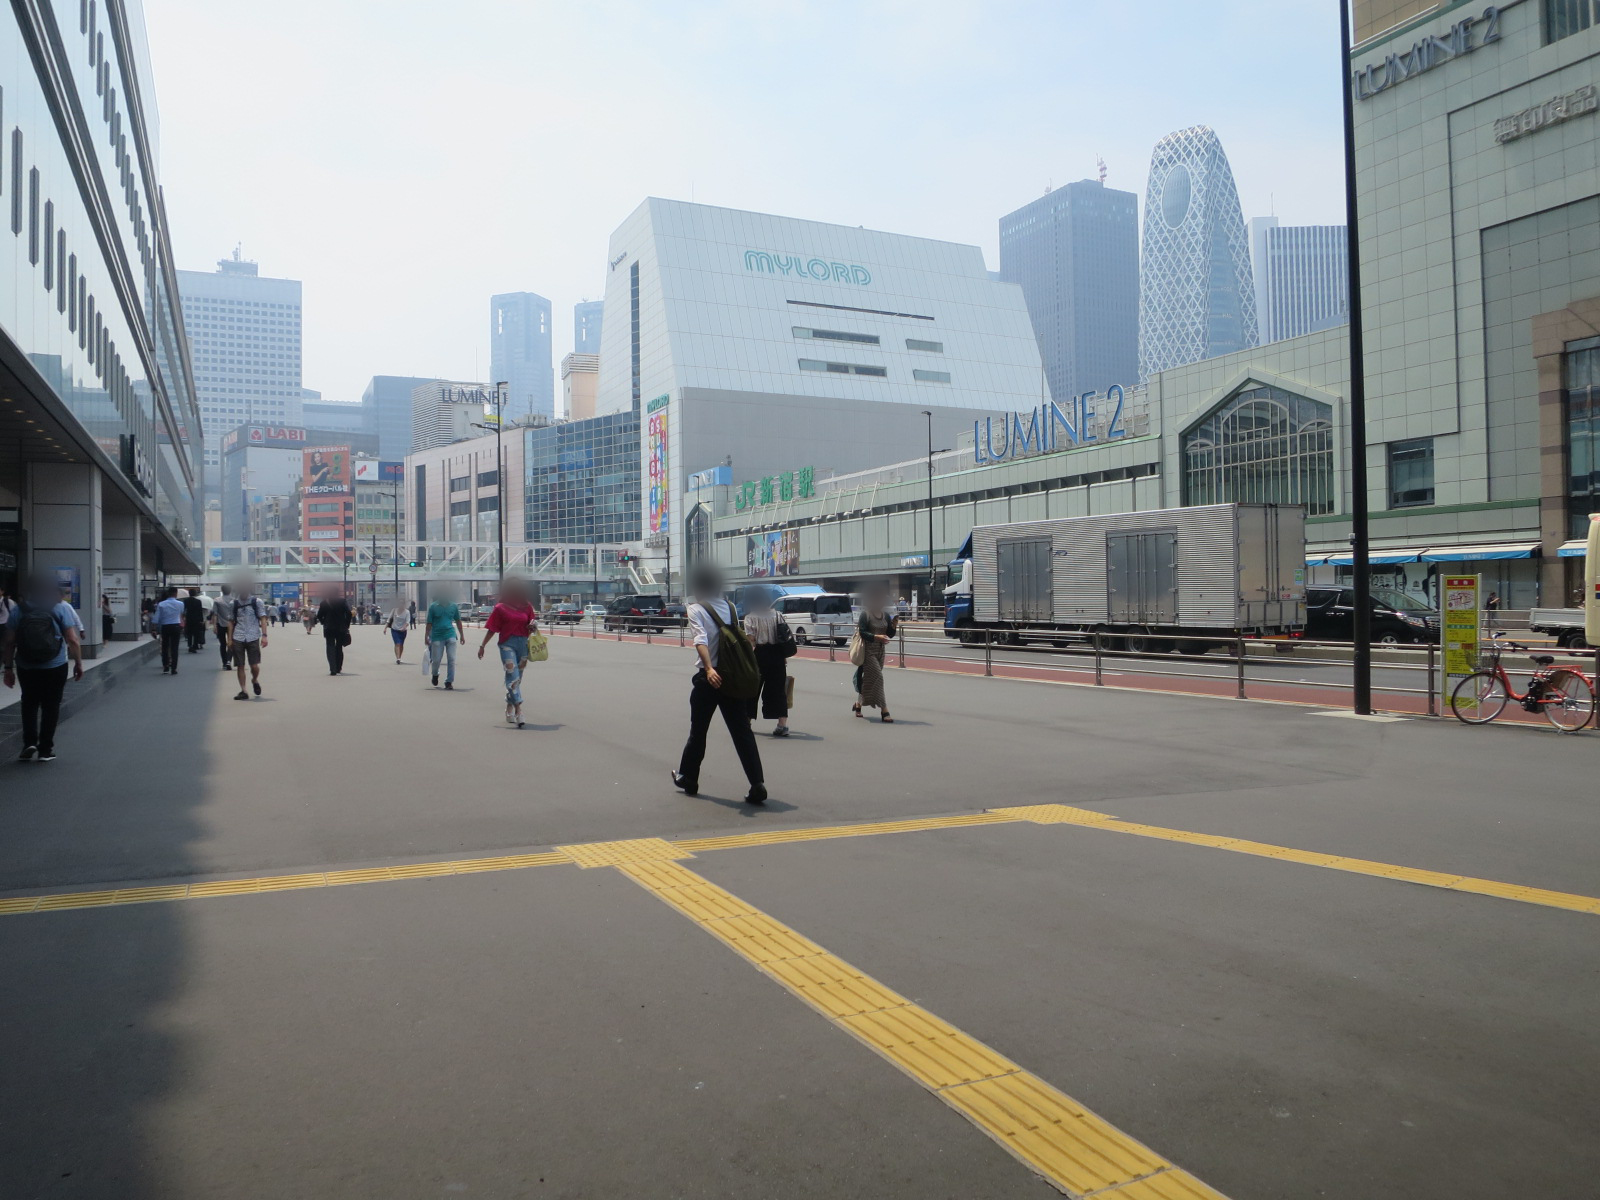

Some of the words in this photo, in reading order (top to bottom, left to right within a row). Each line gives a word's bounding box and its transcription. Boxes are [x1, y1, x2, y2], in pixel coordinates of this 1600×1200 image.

[1354, 16, 1473, 100] LUMINE
[1482, 6, 1501, 43] 2
[1493, 85, 1598, 144] 無印良品
[744, 250, 871, 285] MYLORD
[442, 388, 498, 405] LUMINE
[265, 427, 306, 441] LABI
[975, 390, 1098, 463] LUMINE
[1107, 384, 1125, 437] 2
